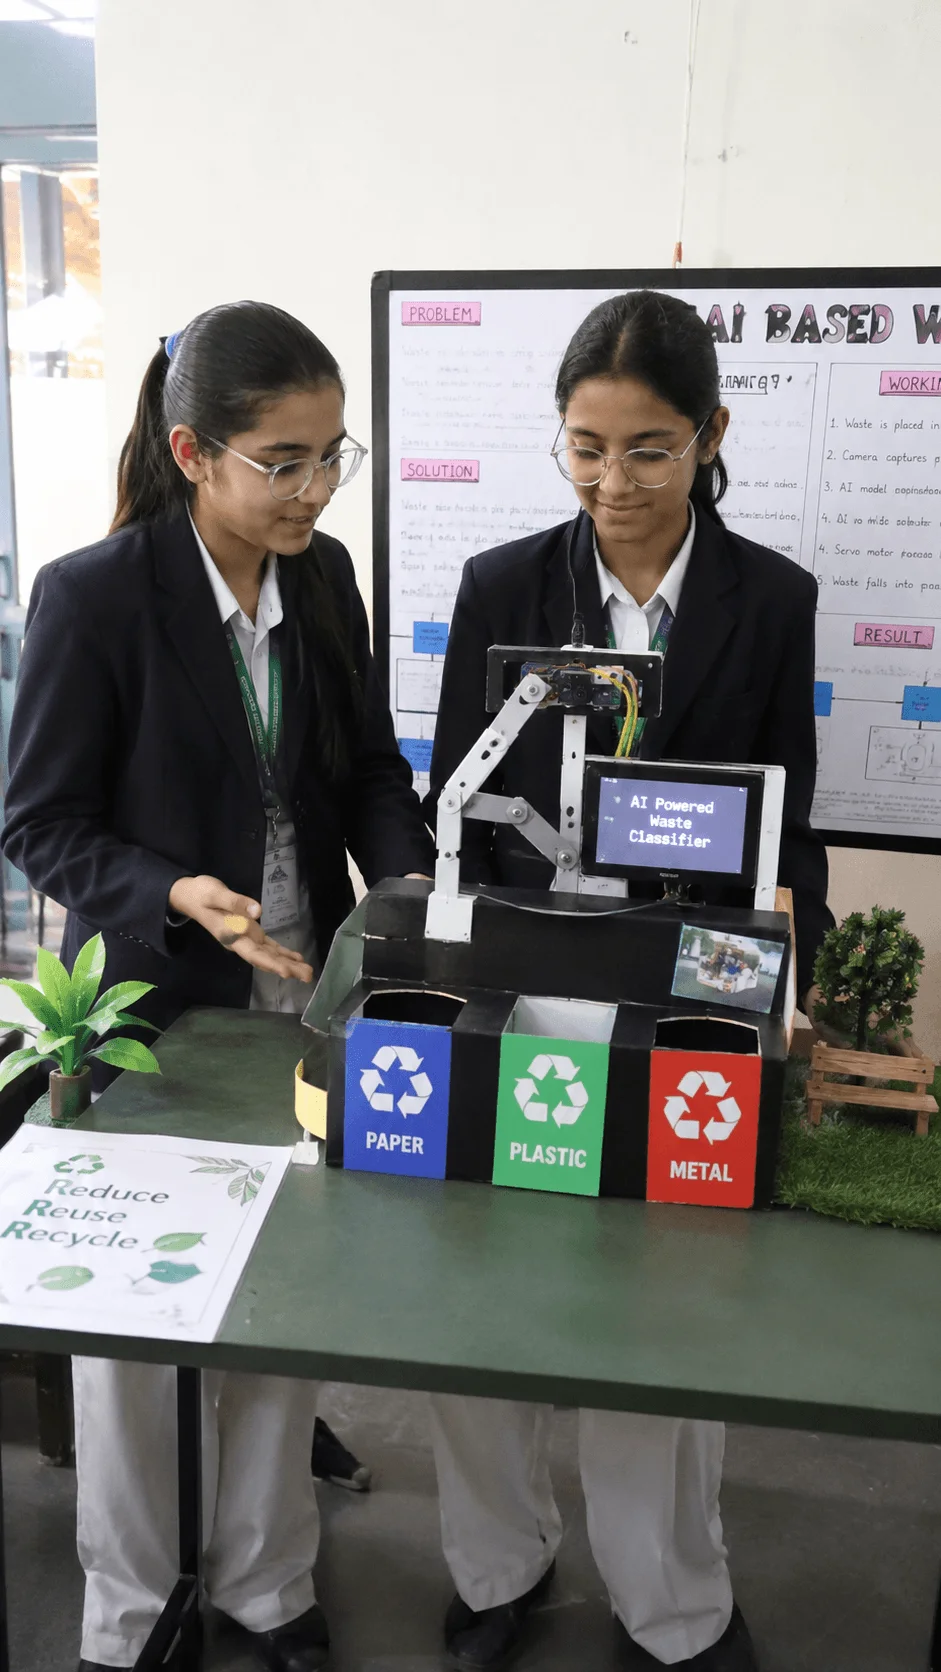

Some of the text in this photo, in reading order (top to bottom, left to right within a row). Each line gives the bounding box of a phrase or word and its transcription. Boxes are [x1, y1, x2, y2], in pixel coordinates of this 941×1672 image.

[409, 306, 472, 322] PROBLEM
[705, 302, 746, 343] AI
[765, 303, 894, 344] BASED
[830, 418, 839, 428] 1.
[845, 418, 872, 429] Waste
[880, 420, 888, 429] is
[894, 419, 924, 433] placed
[826, 449, 836, 460] 2.
[842, 449, 878, 461] Camera
[886, 453, 927, 465] captures
[407, 463, 473, 478] SOLUTION
[824, 481, 833, 492] 3.
[839, 482, 853, 492] AI
[860, 484, 887, 494] model
[818, 544, 829, 555] 4.
[834, 544, 860, 556] Servo
[867, 548, 894, 557] motor
[832, 576, 859, 587] Waste
[866, 577, 887, 591] falls
[895, 580, 914, 589] into
[864, 627, 922, 643] RESULT
[630, 795, 714, 814] AI Powered
[649, 814, 692, 829] Waste
[629, 829, 711, 848] Classifier
[366, 1131, 424, 1155] PAPER
[509, 1142, 587, 1169] PLASTIC
[669, 1160, 733, 1183] METAL
[44, 1178, 169, 1204] Reduce
[22, 1199, 127, 1223] Reuse
[0, 1220, 139, 1249] Recycle
